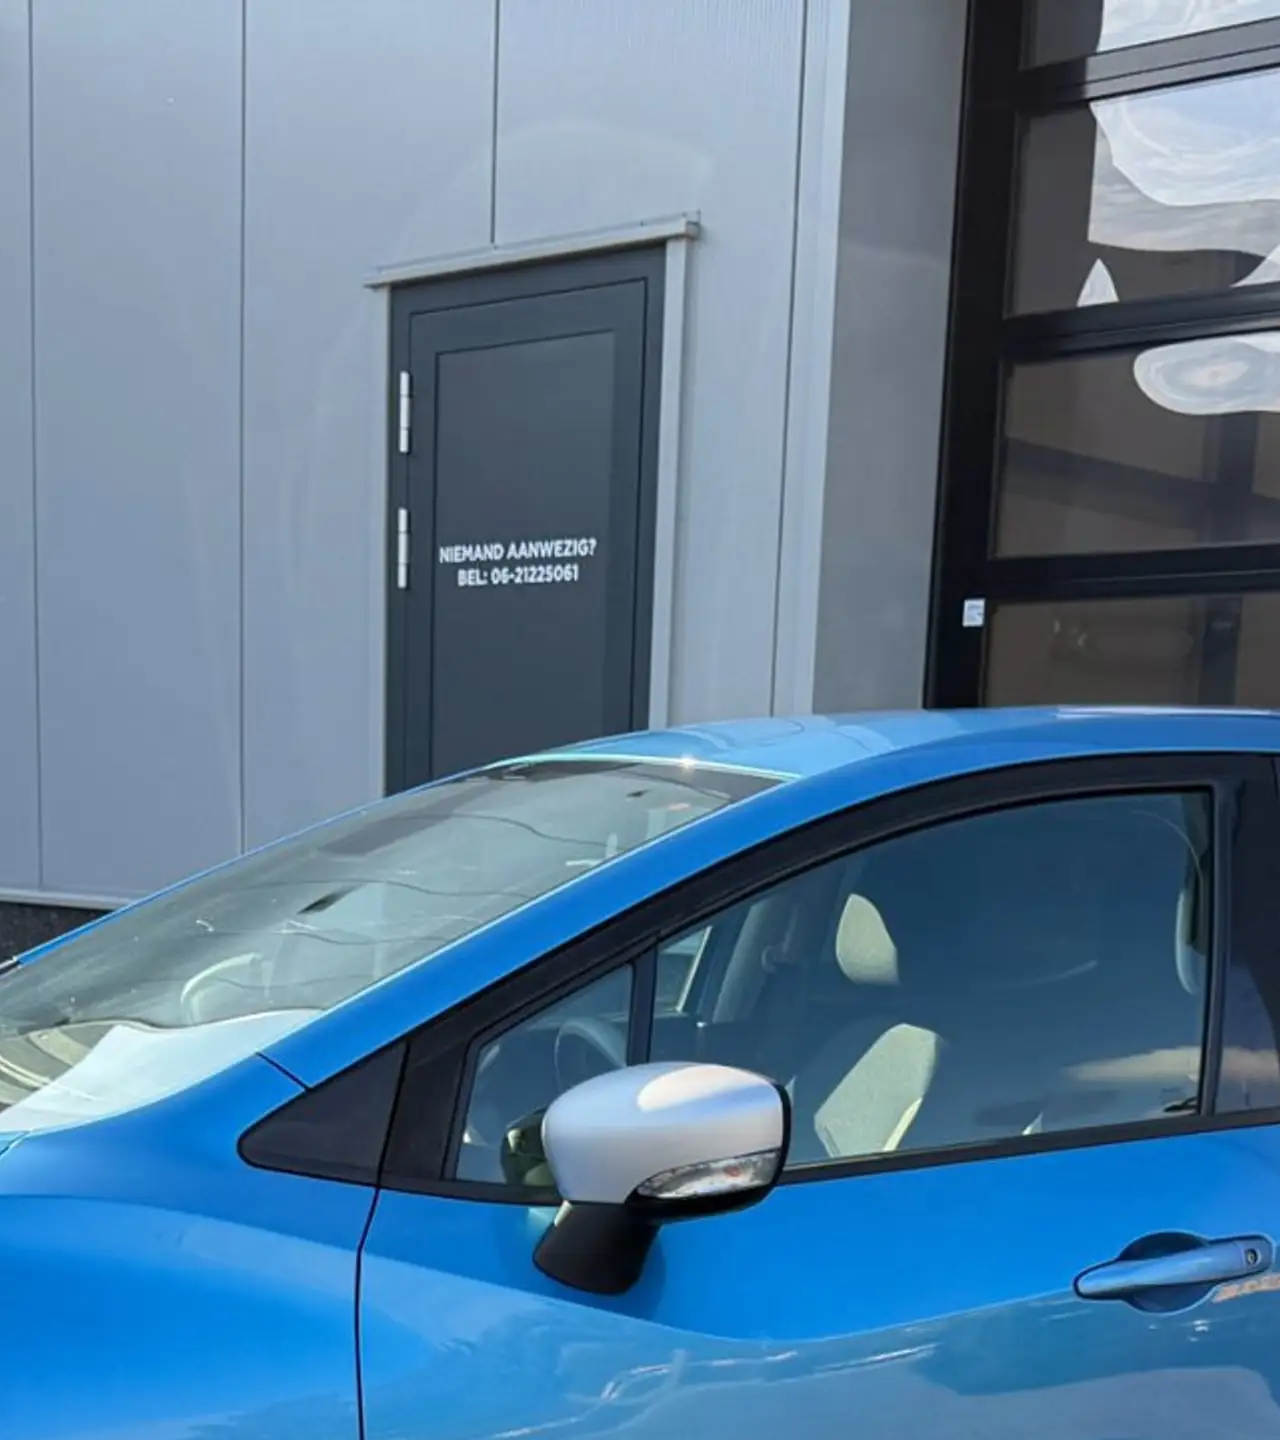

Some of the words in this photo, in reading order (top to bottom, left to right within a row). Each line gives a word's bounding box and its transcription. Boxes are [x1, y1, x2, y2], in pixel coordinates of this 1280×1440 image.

[439, 545, 503, 563] NIEMAND
[506, 537, 597, 559] AANWEZIG?
[457, 569, 488, 587] BEL:
